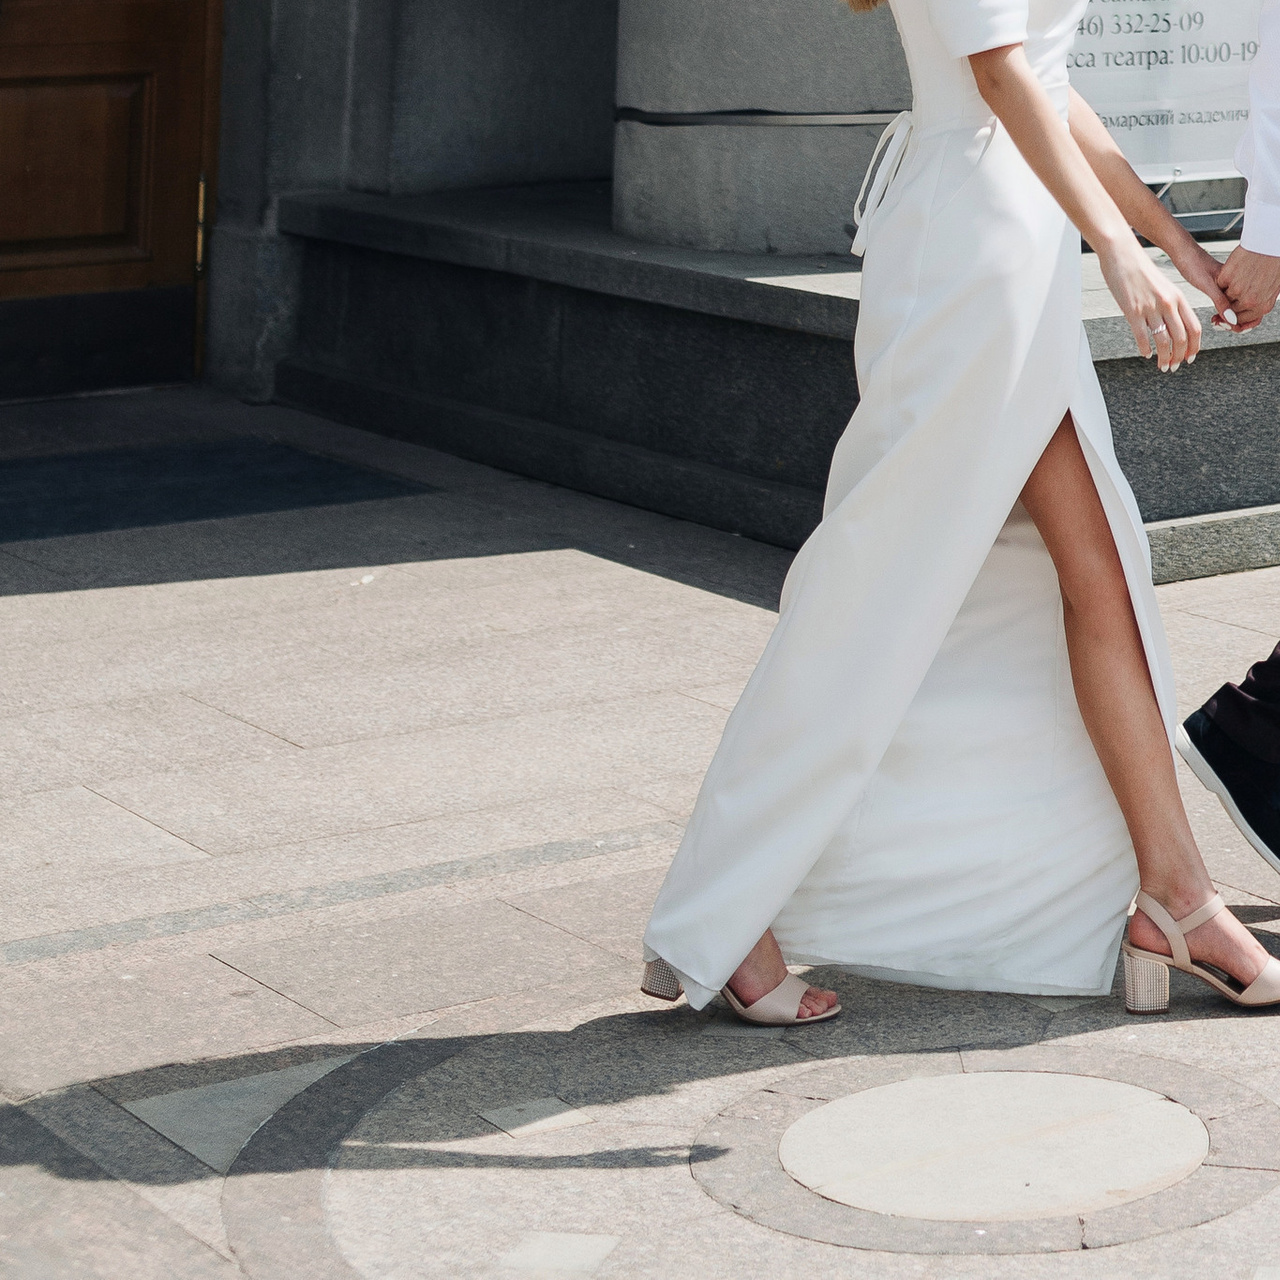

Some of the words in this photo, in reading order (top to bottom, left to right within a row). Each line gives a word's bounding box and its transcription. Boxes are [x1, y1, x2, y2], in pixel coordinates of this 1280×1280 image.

[1110, 11, 1204, 36] 332-25-09
[1103, 49, 1174, 70] театра:
[1096, 109, 1175, 131] амарский
